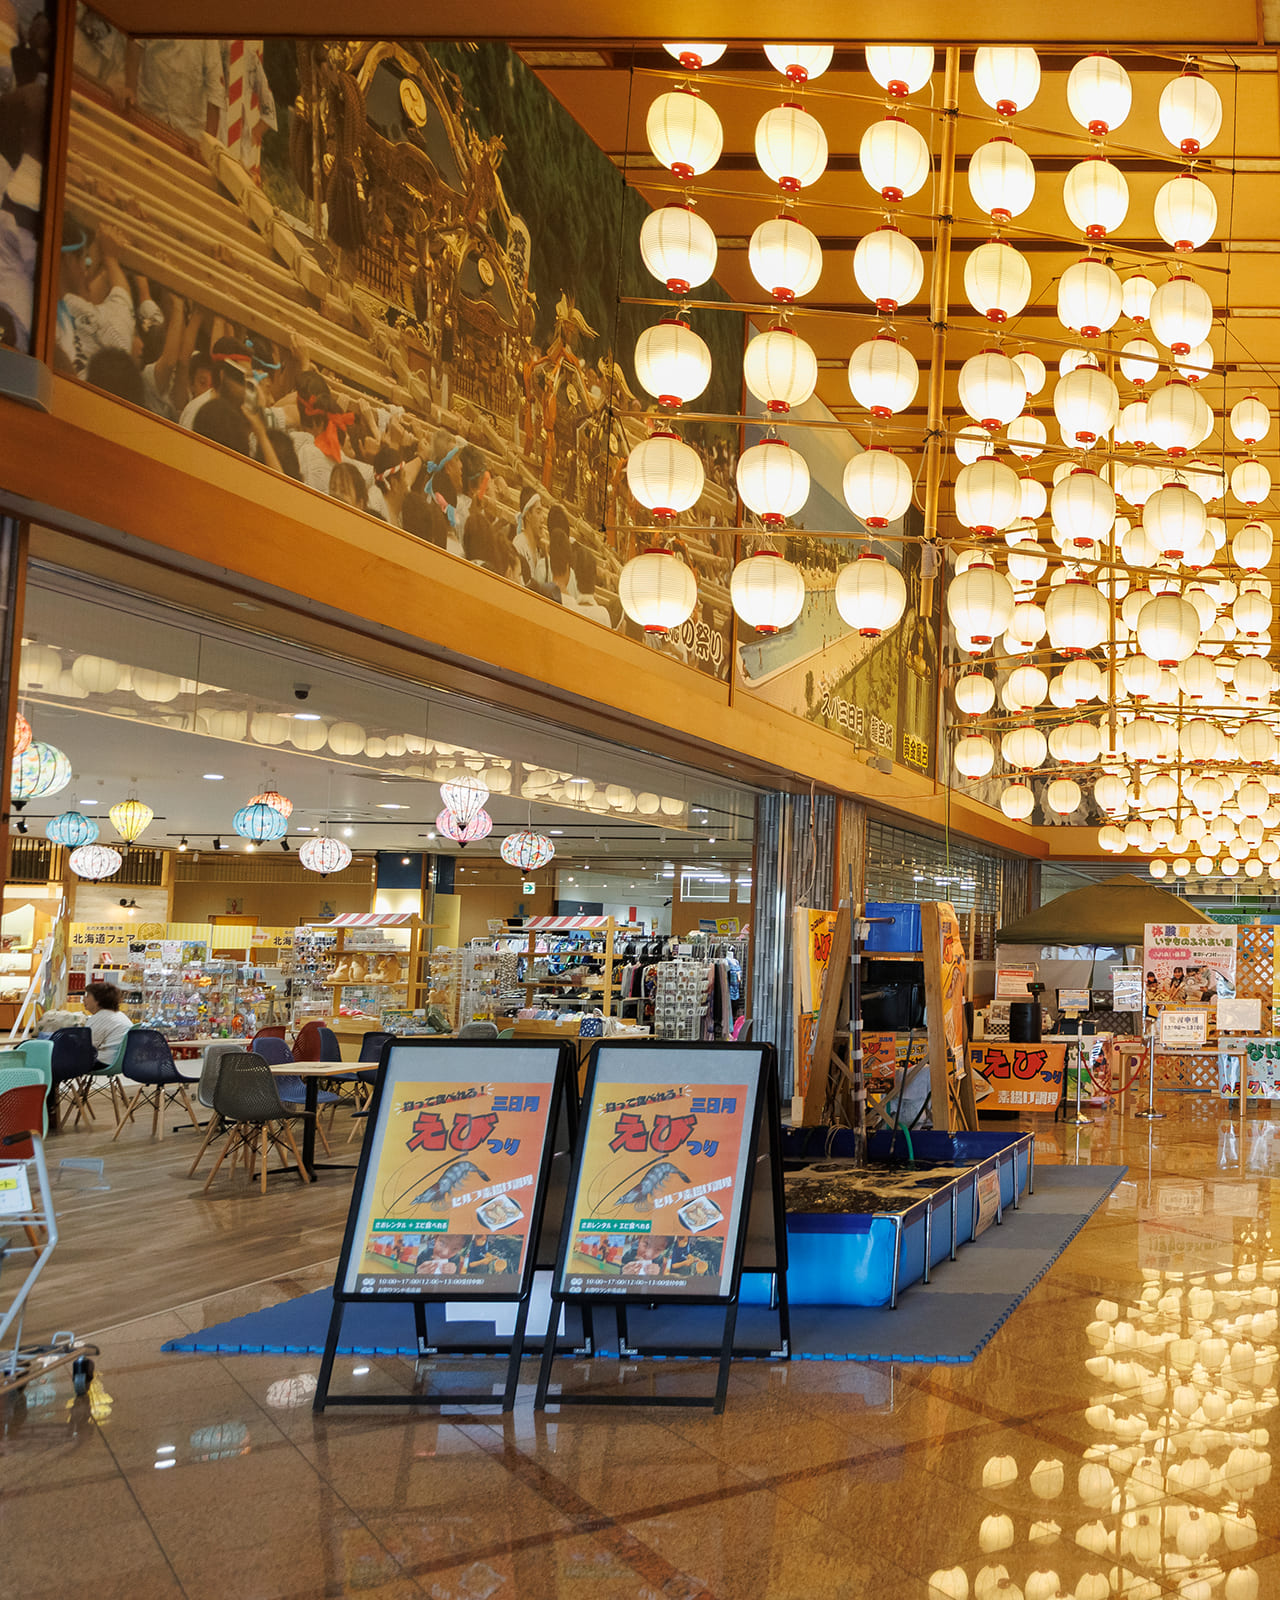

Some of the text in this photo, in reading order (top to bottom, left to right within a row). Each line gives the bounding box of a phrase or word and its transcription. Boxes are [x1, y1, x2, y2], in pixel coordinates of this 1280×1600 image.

[664, 617, 723, 666] の祭り
[820, 690, 864, 736] スパ三日月
[73, 933, 136, 945] 北海道フェア
[273, 936, 292, 946] 北海
[982, 1048, 1048, 1080] えび
[1041, 1070, 1063, 1085] つり
[491, 1095, 541, 1113] 三日月
[689, 1097, 737, 1114] 三日月
[997, 1090, 1059, 1106] 素揚げ調理
[405, 1111, 499, 1153] えび
[608, 1112, 698, 1154] えび
[486, 1138, 521, 1156] つり
[686, 1140, 720, 1158] つり
[451, 1174, 534, 1209] セルフ素揚げ調理
[653, 1176, 733, 1210] セルフ素揚げ調理
